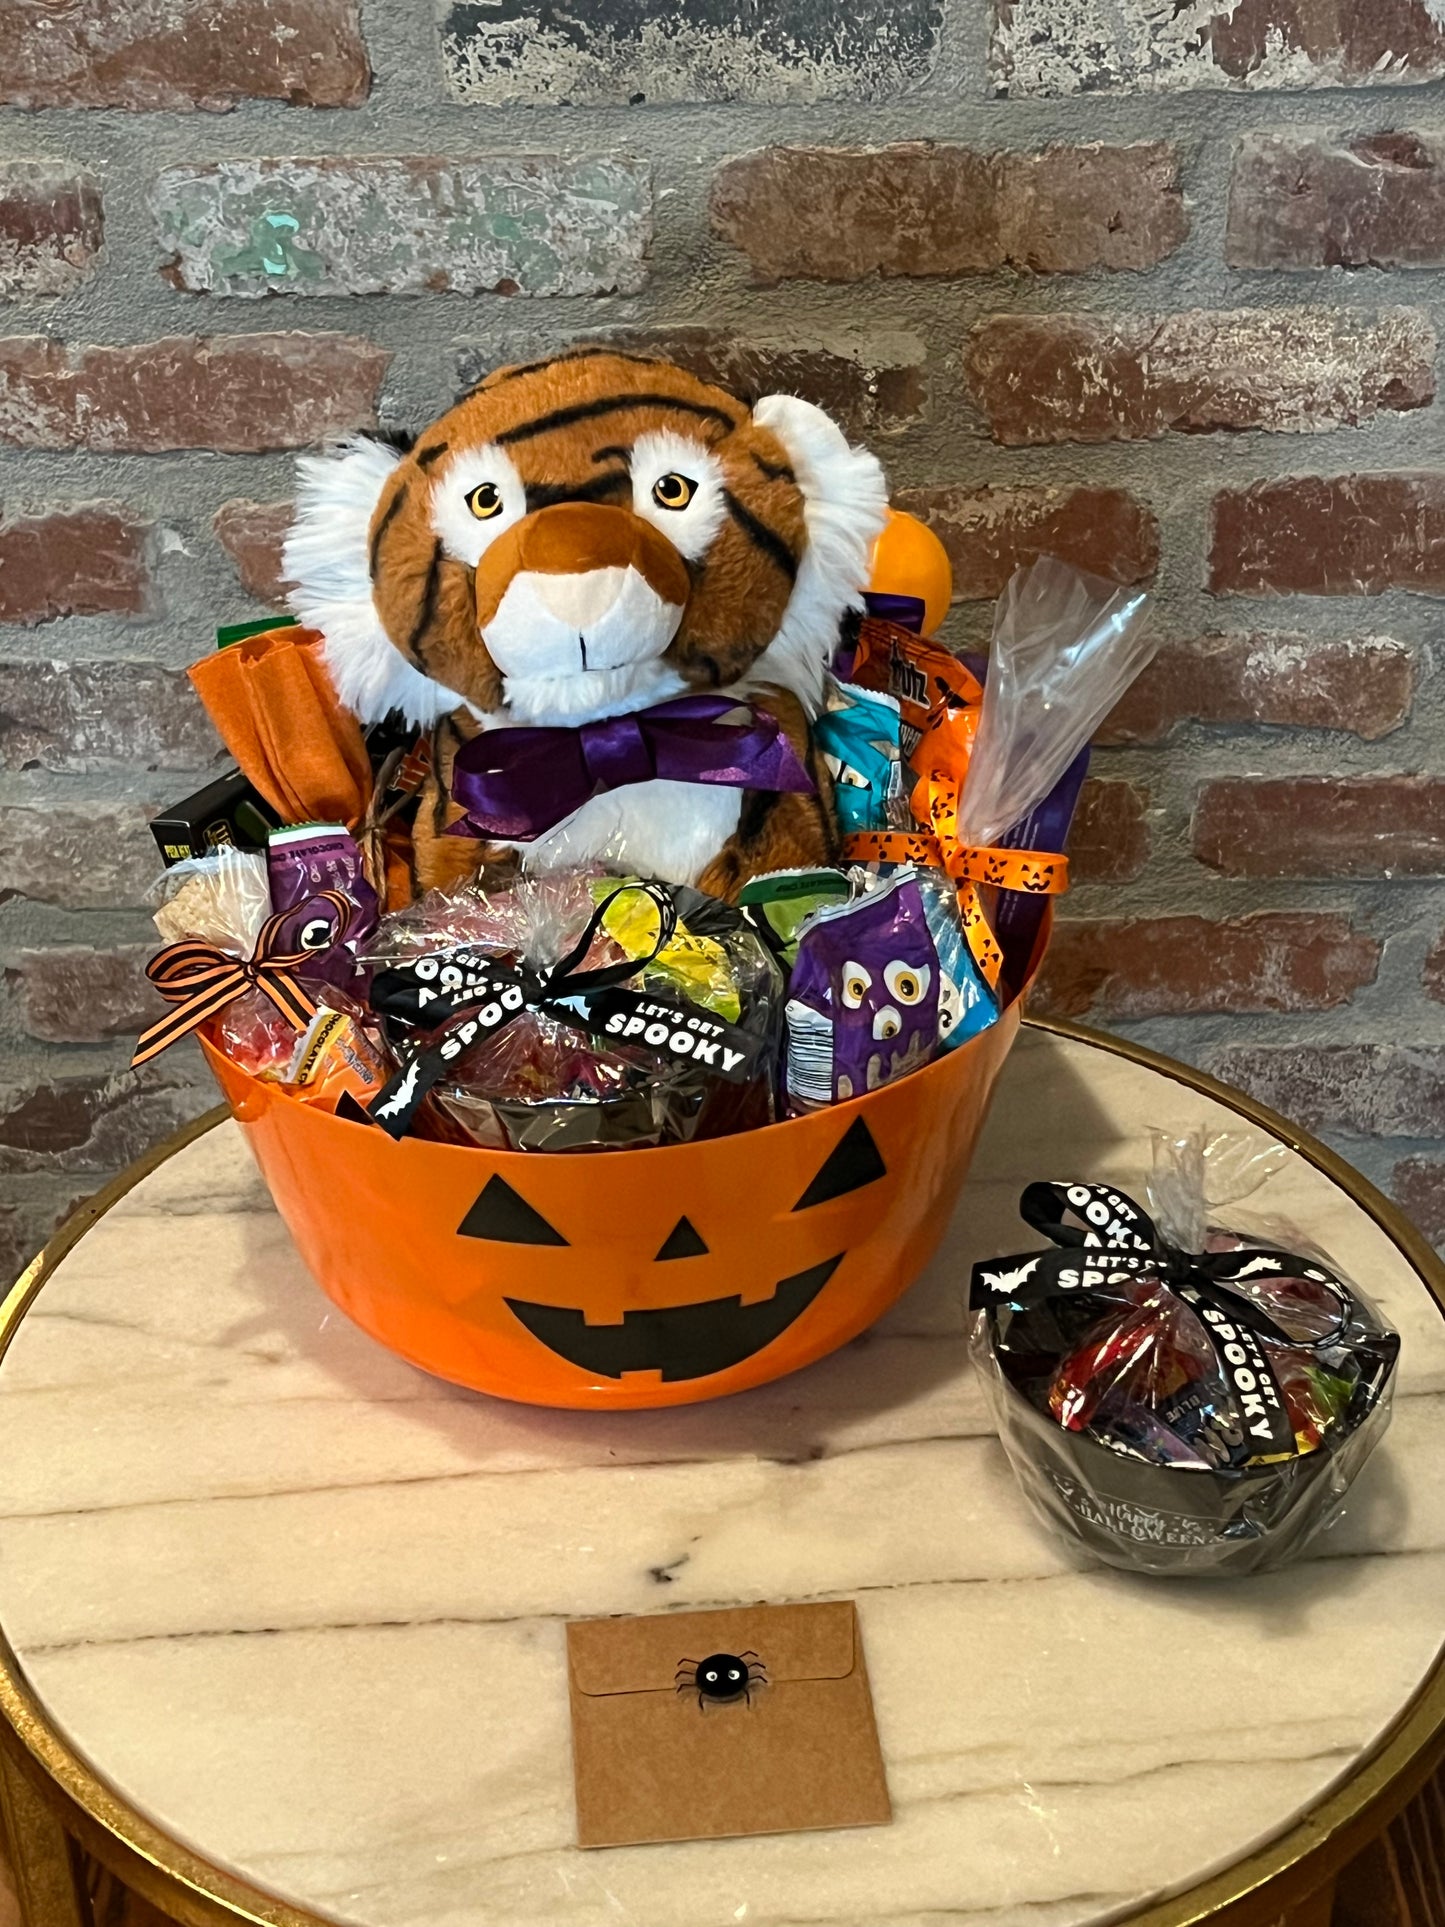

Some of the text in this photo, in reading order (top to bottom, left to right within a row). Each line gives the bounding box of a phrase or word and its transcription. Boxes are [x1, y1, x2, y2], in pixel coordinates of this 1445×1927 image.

[456, 954, 491, 971] GET
[305, 1013, 343, 1071] CHOCOLATE
[440, 984, 524, 1060] SPOO
[635, 1002, 725, 1037] LET'S GET
[604, 1013, 746, 1073] SPOOKY
[1107, 1194, 1138, 1221] GET
[1057, 1269, 1131, 1289] SPO
[1085, 1255, 1139, 1269] LET'S
[1202, 1309, 1274, 1440] SPOOKY
[1235, 1323, 1280, 1408] LET'S GET
